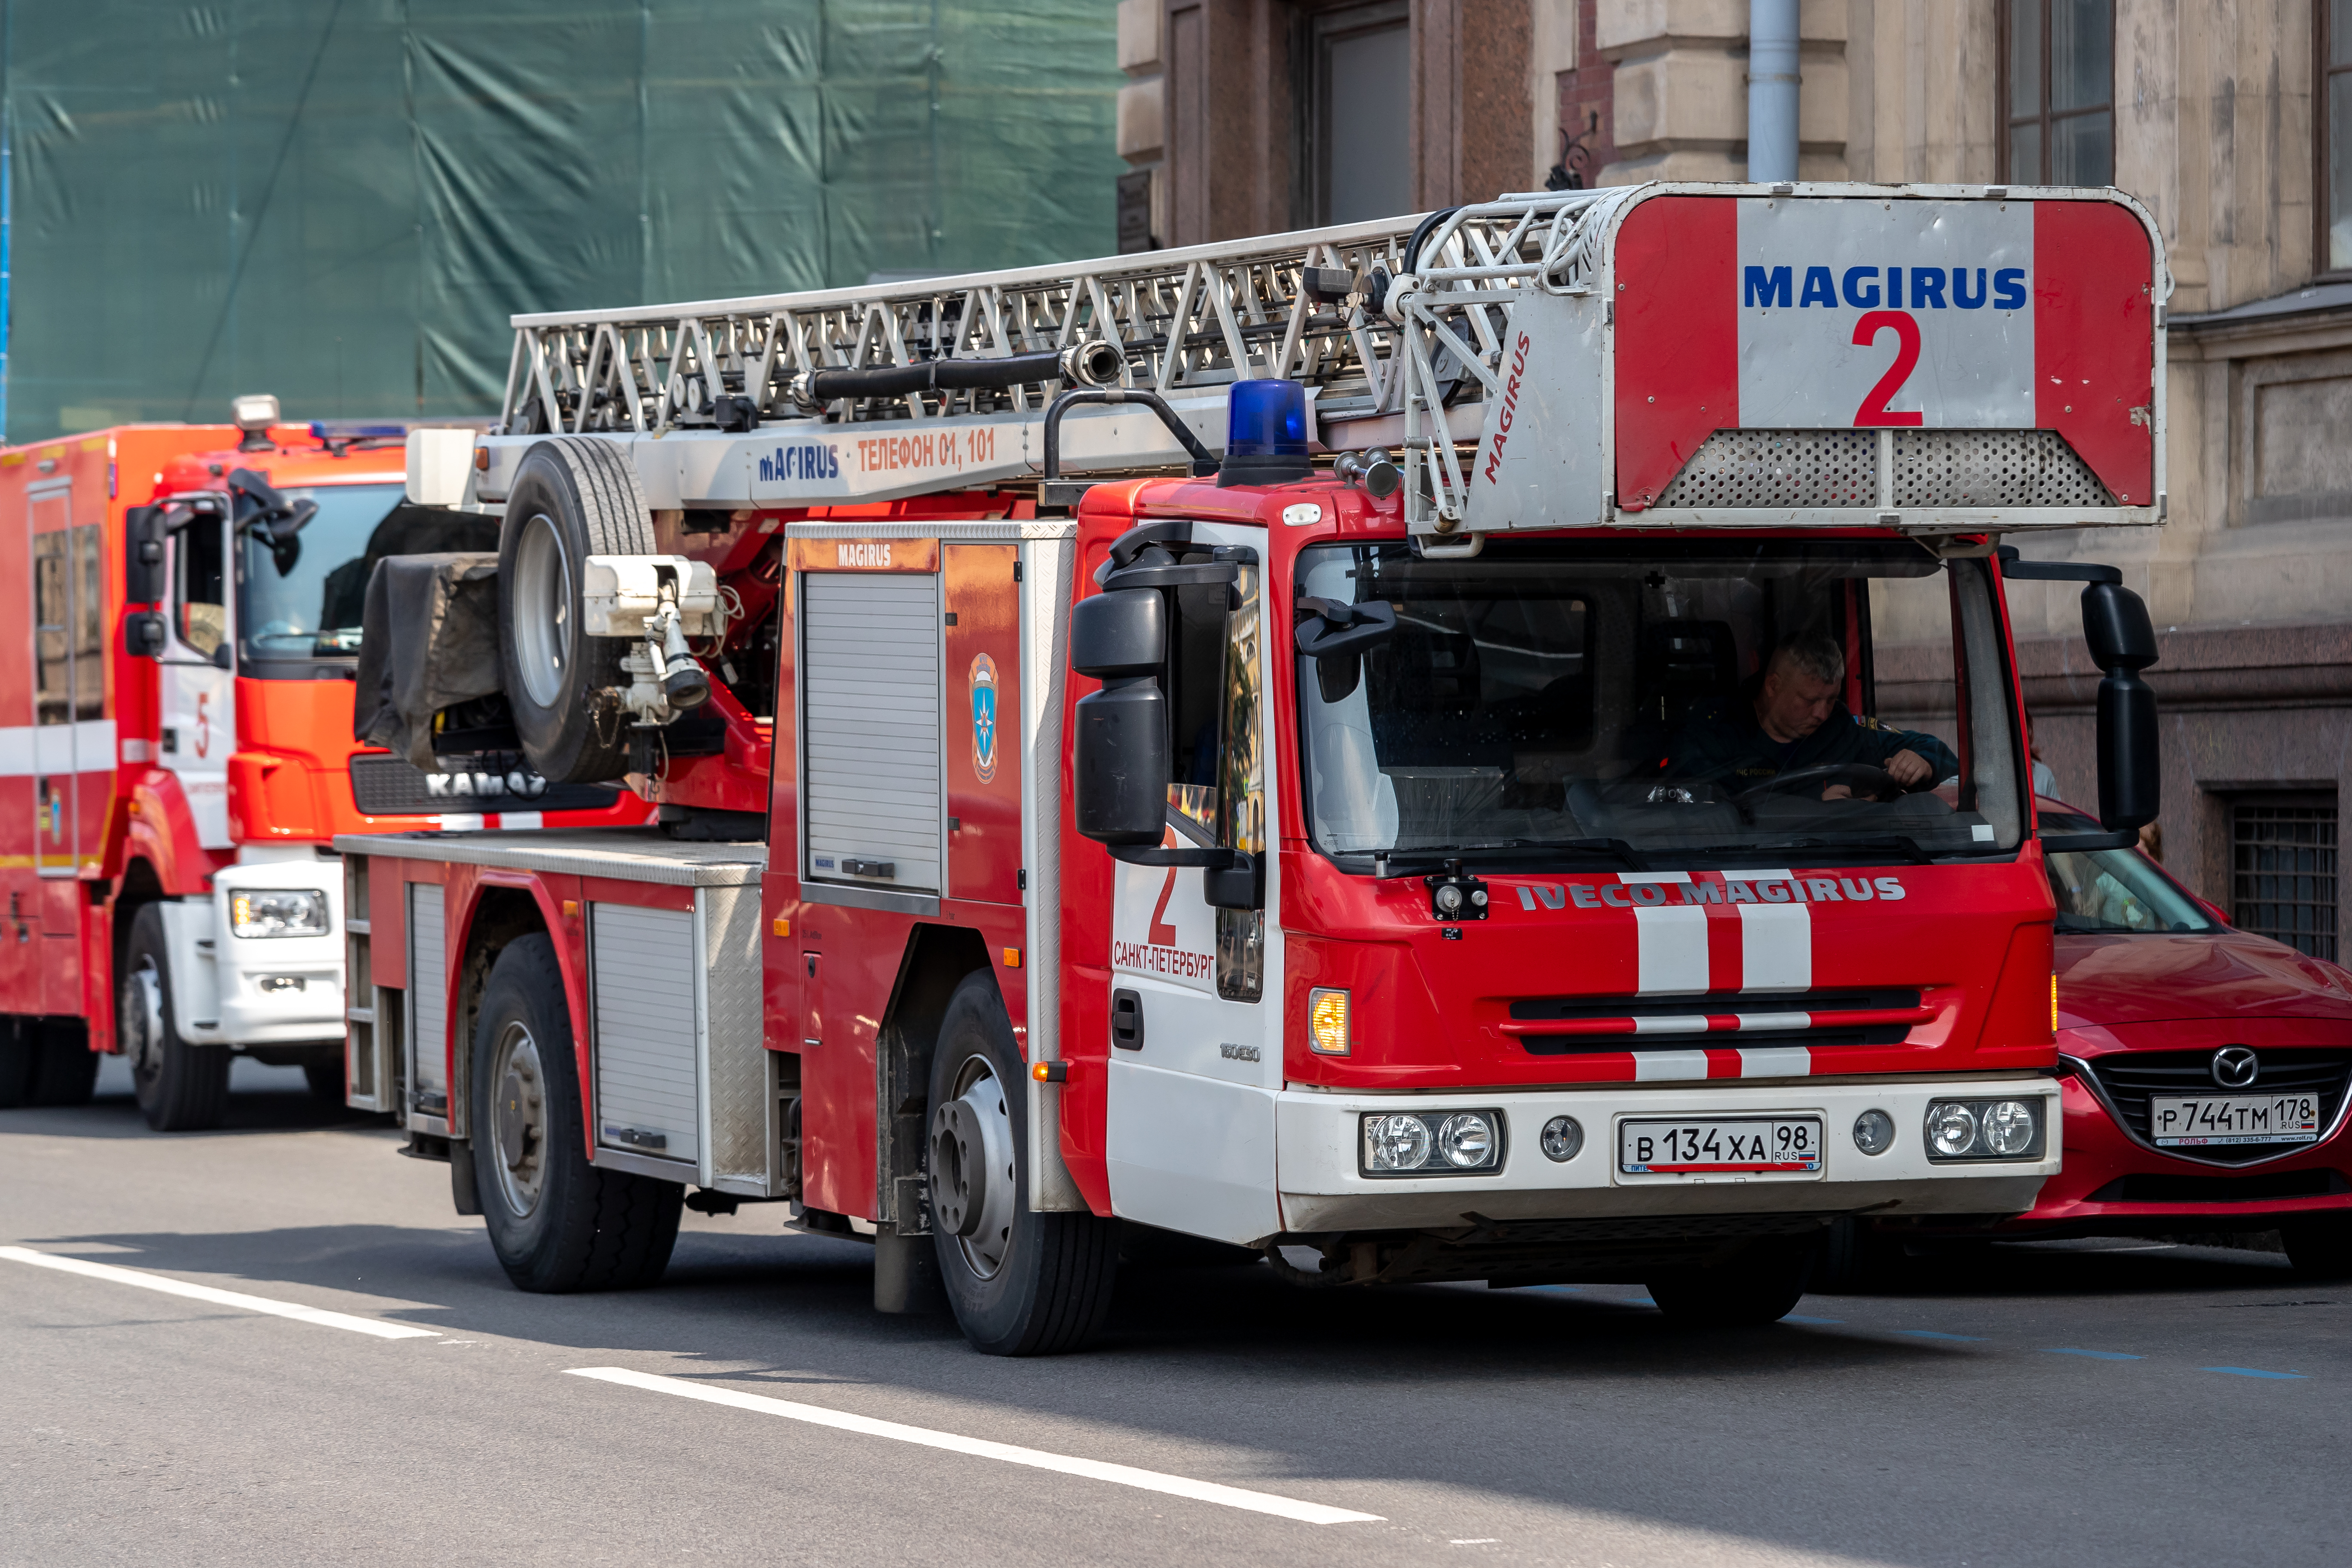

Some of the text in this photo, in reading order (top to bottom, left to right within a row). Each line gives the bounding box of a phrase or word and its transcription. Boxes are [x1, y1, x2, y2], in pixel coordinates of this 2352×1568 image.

[1744, 265, 2027, 310] MAGIRUS
[1851, 310, 1923, 427] 2
[1485, 331, 1530, 485] MAGIRUS
[858, 427, 995, 472] ТЕЛЕФОН 01, 101
[838, 544, 891, 567] MAGIRUS
[195, 692, 209, 759] 5
[425, 772, 547, 797] KAMAZ
[1749, 768, 1776, 776] РОССИИ
[1148, 825, 1178, 947] 2
[1516, 876, 1906, 911] IVECO MAGIRUS
[1114, 940, 1215, 980] САНКТ-ПЕТЕРБУРГ
[1219, 1042, 1261, 1063] 150E30
[2274, 1098, 2310, 1121] 178
[1776, 1125, 1808, 1151] 98
[2281, 1121, 2300, 1130] RUS
[1775, 1152, 1798, 1161] RUS
